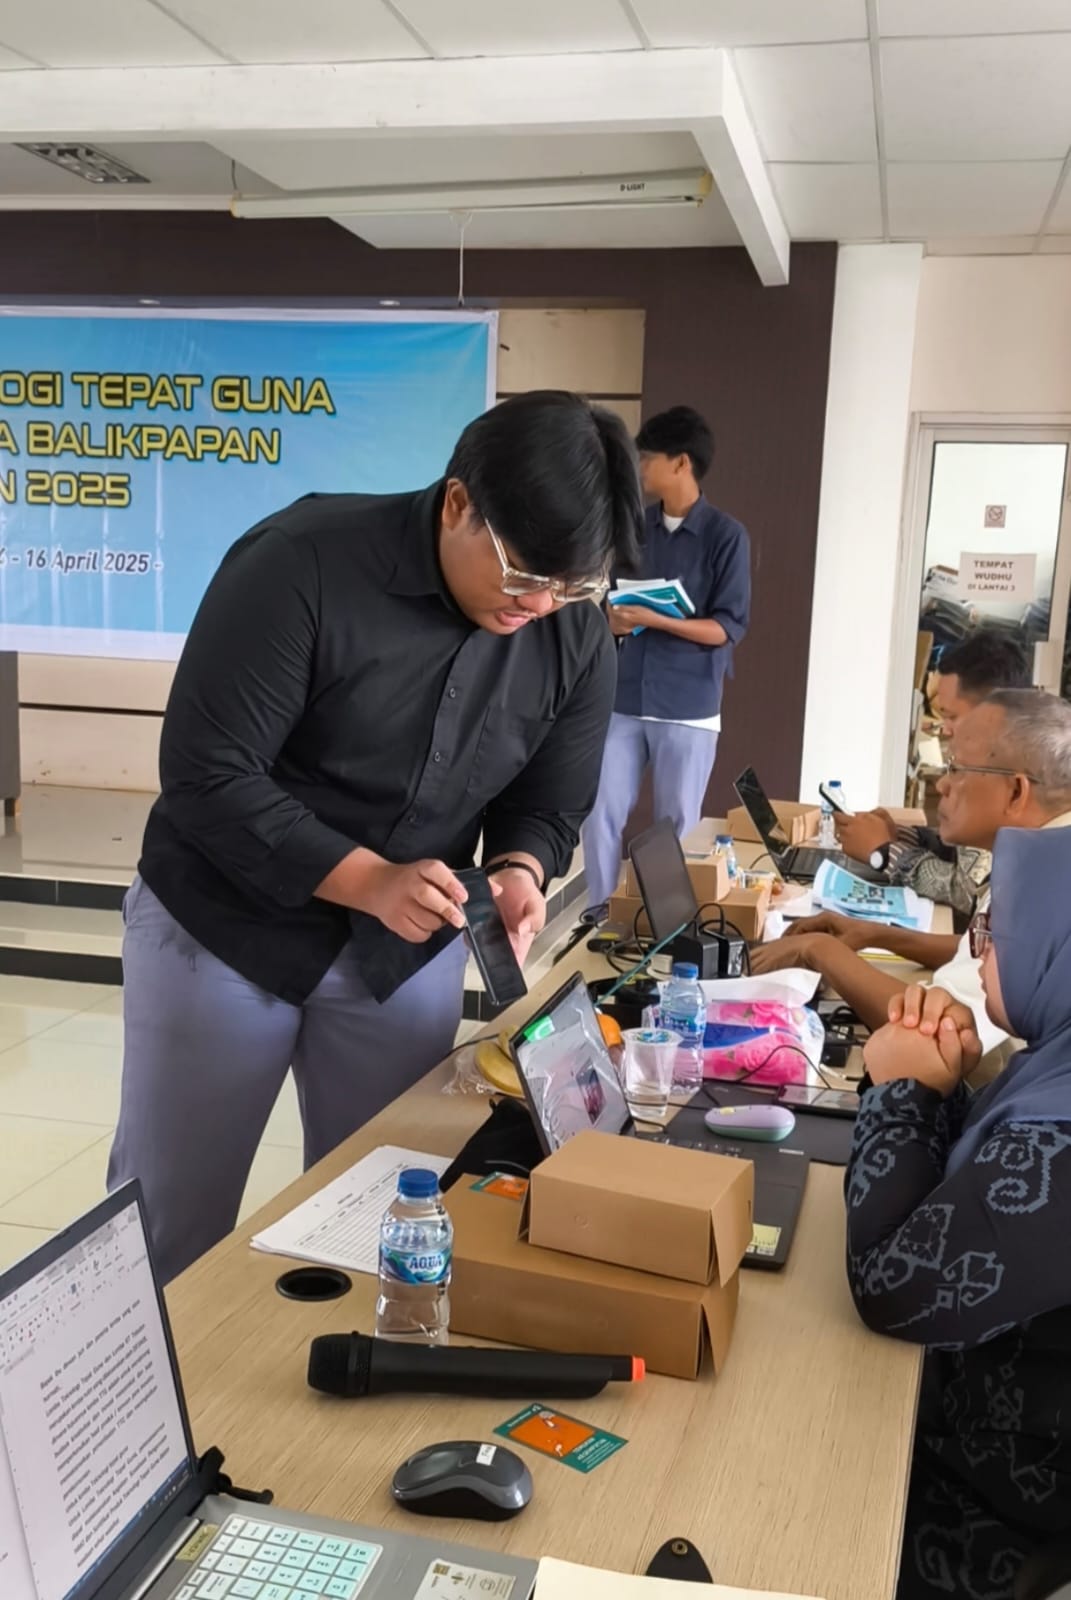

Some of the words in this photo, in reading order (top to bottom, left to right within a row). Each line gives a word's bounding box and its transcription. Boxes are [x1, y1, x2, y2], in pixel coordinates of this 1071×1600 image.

[0, 371, 63, 406] OGI
[71, 372, 204, 411] TEPAT
[211, 377, 337, 415] GUNA
[27, 420, 281, 464] BALIKPAPAN
[25, 471, 131, 507] 2025
[27, 549, 46, 569] 16
[51, 551, 97, 573] April
[103, 552, 150, 573] 2025
[974, 560, 1015, 569] TEMPAT
[974, 572, 1013, 581] WUDHU
[409, 1255, 443, 1270] AQUA
